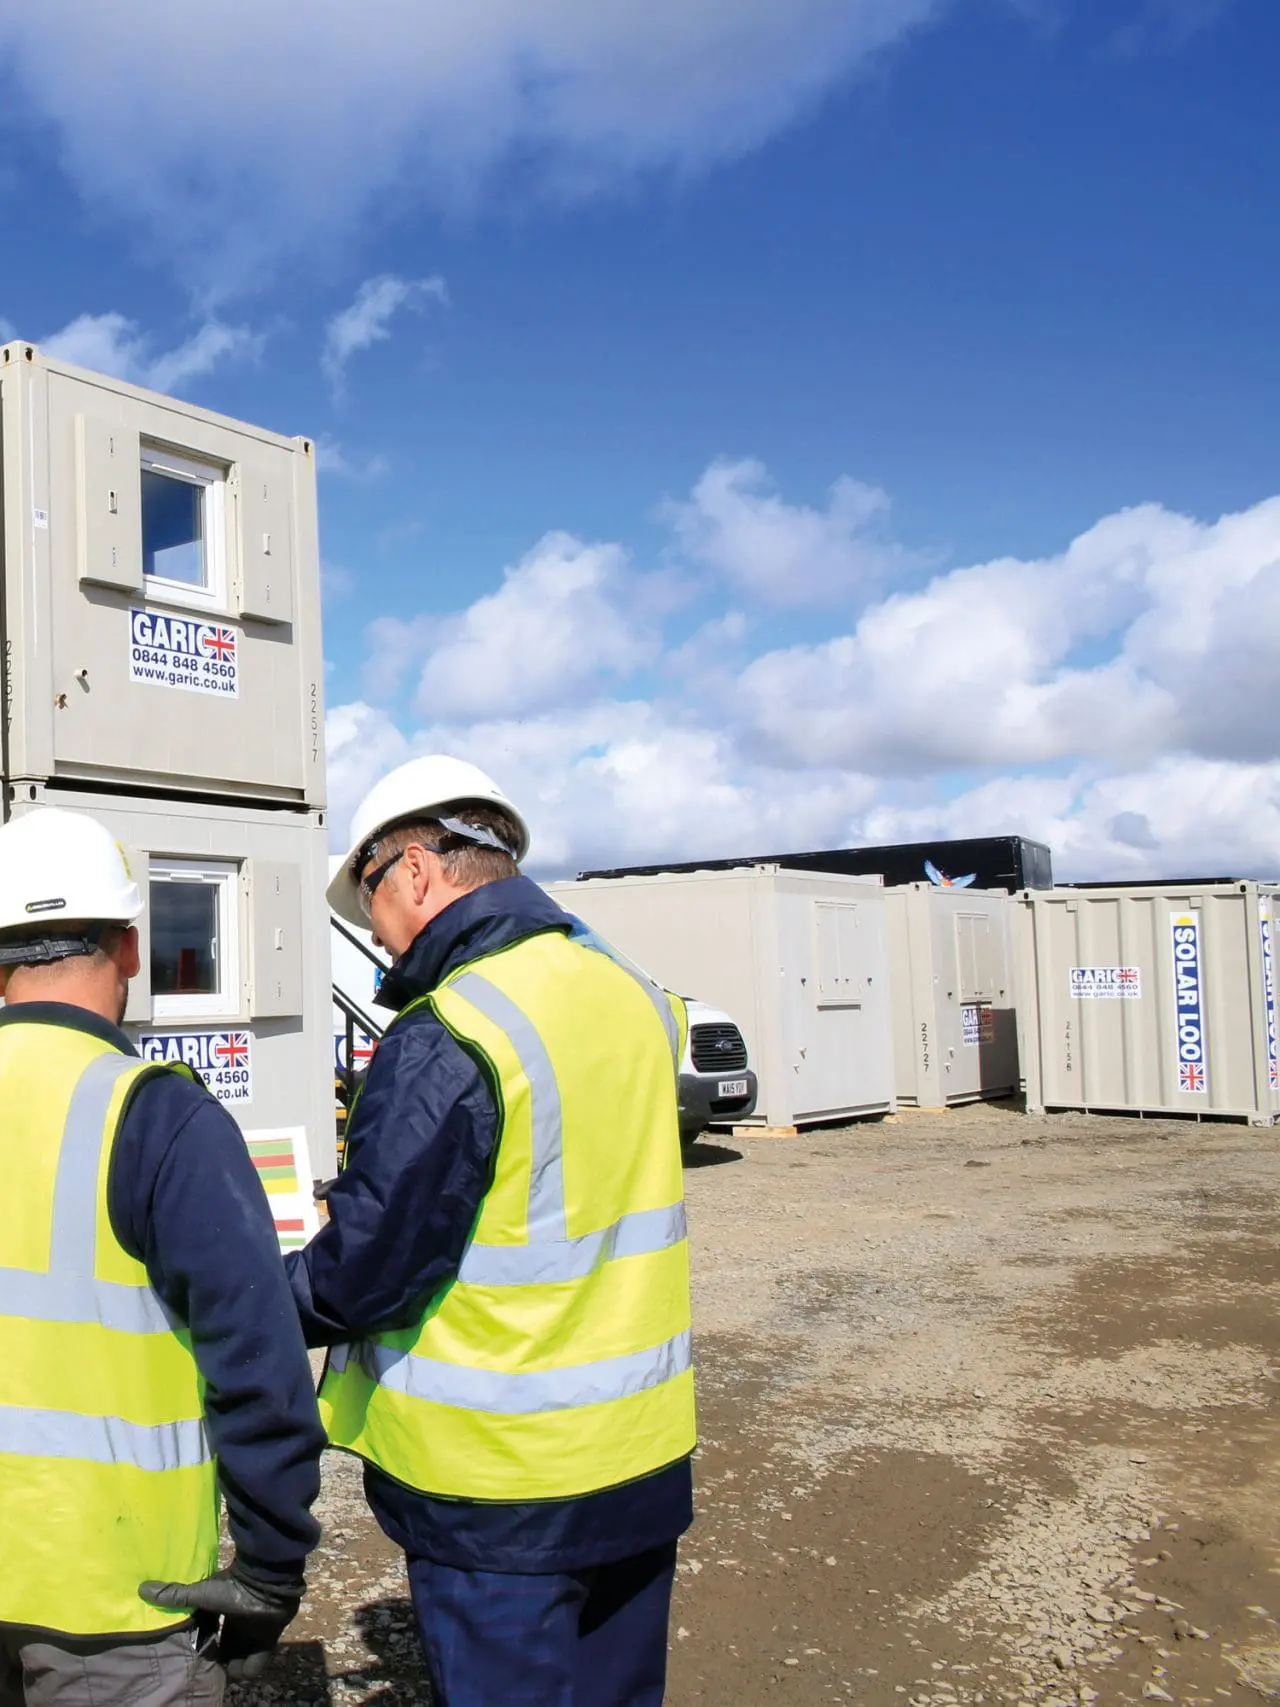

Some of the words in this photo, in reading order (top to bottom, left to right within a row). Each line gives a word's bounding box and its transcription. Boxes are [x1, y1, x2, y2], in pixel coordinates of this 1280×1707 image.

[133, 613, 216, 658] GARIC
[132, 648, 168, 665] 0844
[172, 656, 198, 671] 848
[202, 662, 236, 678] 4560
[133, 666, 236, 692] www.garic.co.uk
[1072, 969, 1119, 983] GARIC
[1174, 928, 1198, 1006] SOLAR
[144, 1035, 226, 1068] GARIC
[921, 1022, 929, 1072] 22727
[1179, 1013, 1201, 1061] LOO
[215, 1070, 249, 1085] 4560
